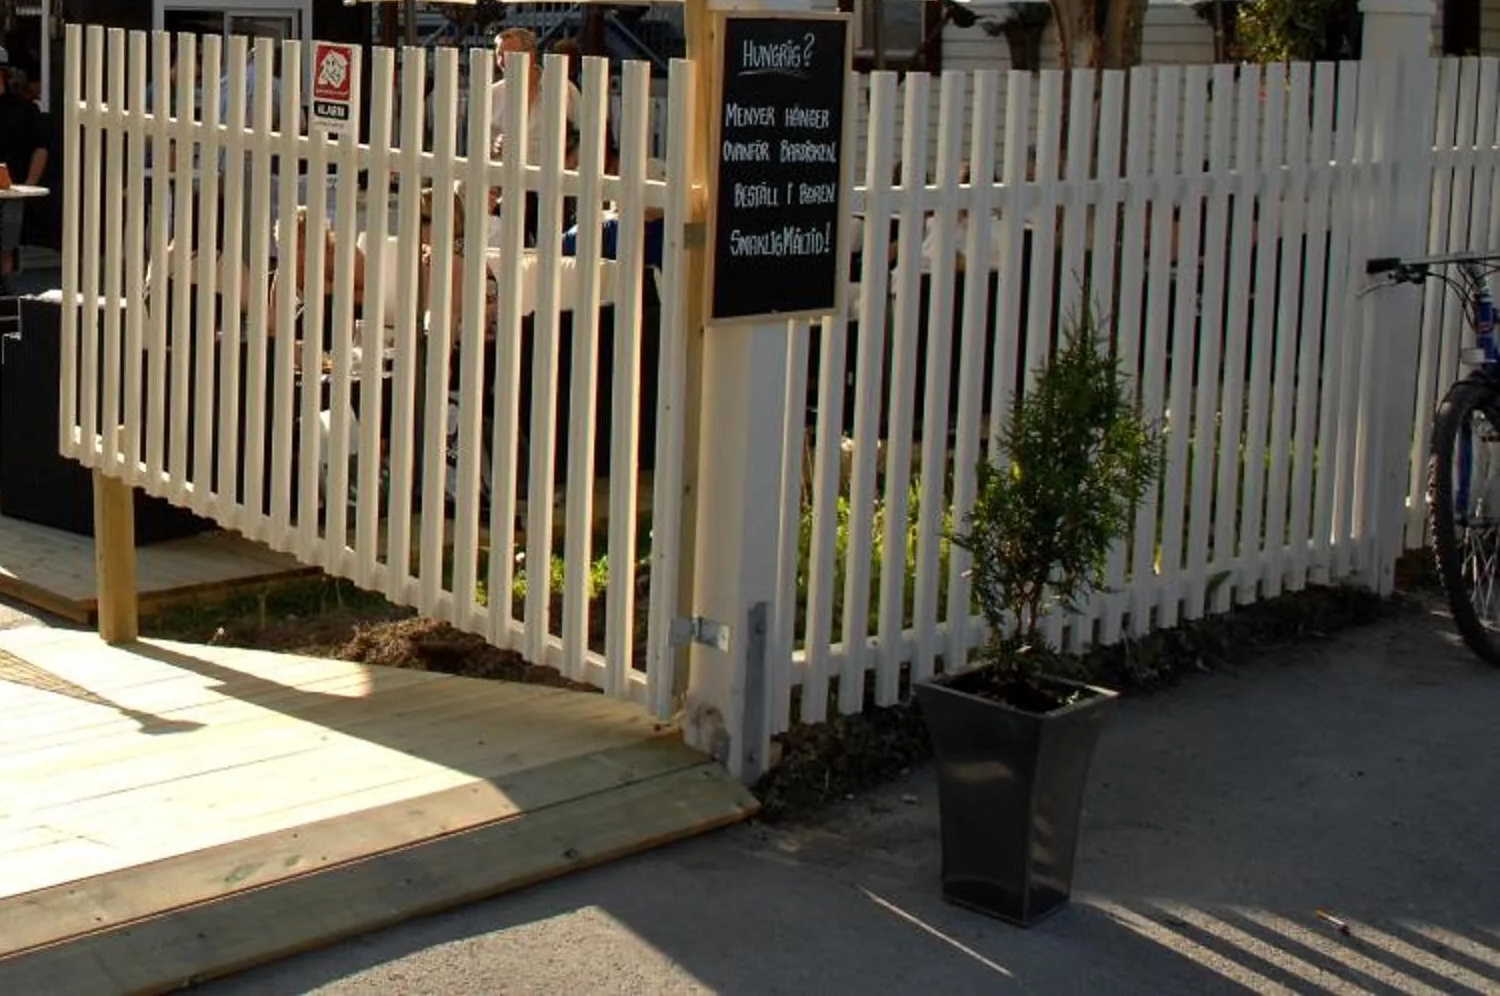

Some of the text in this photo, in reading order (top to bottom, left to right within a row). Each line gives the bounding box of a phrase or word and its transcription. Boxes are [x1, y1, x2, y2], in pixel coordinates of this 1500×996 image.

[742, 32, 816, 68] HUNGRIG?
[725, 102, 775, 127] MENYER
[734, 181, 779, 208] BESTÄLL
[787, 182, 793, 205] I
